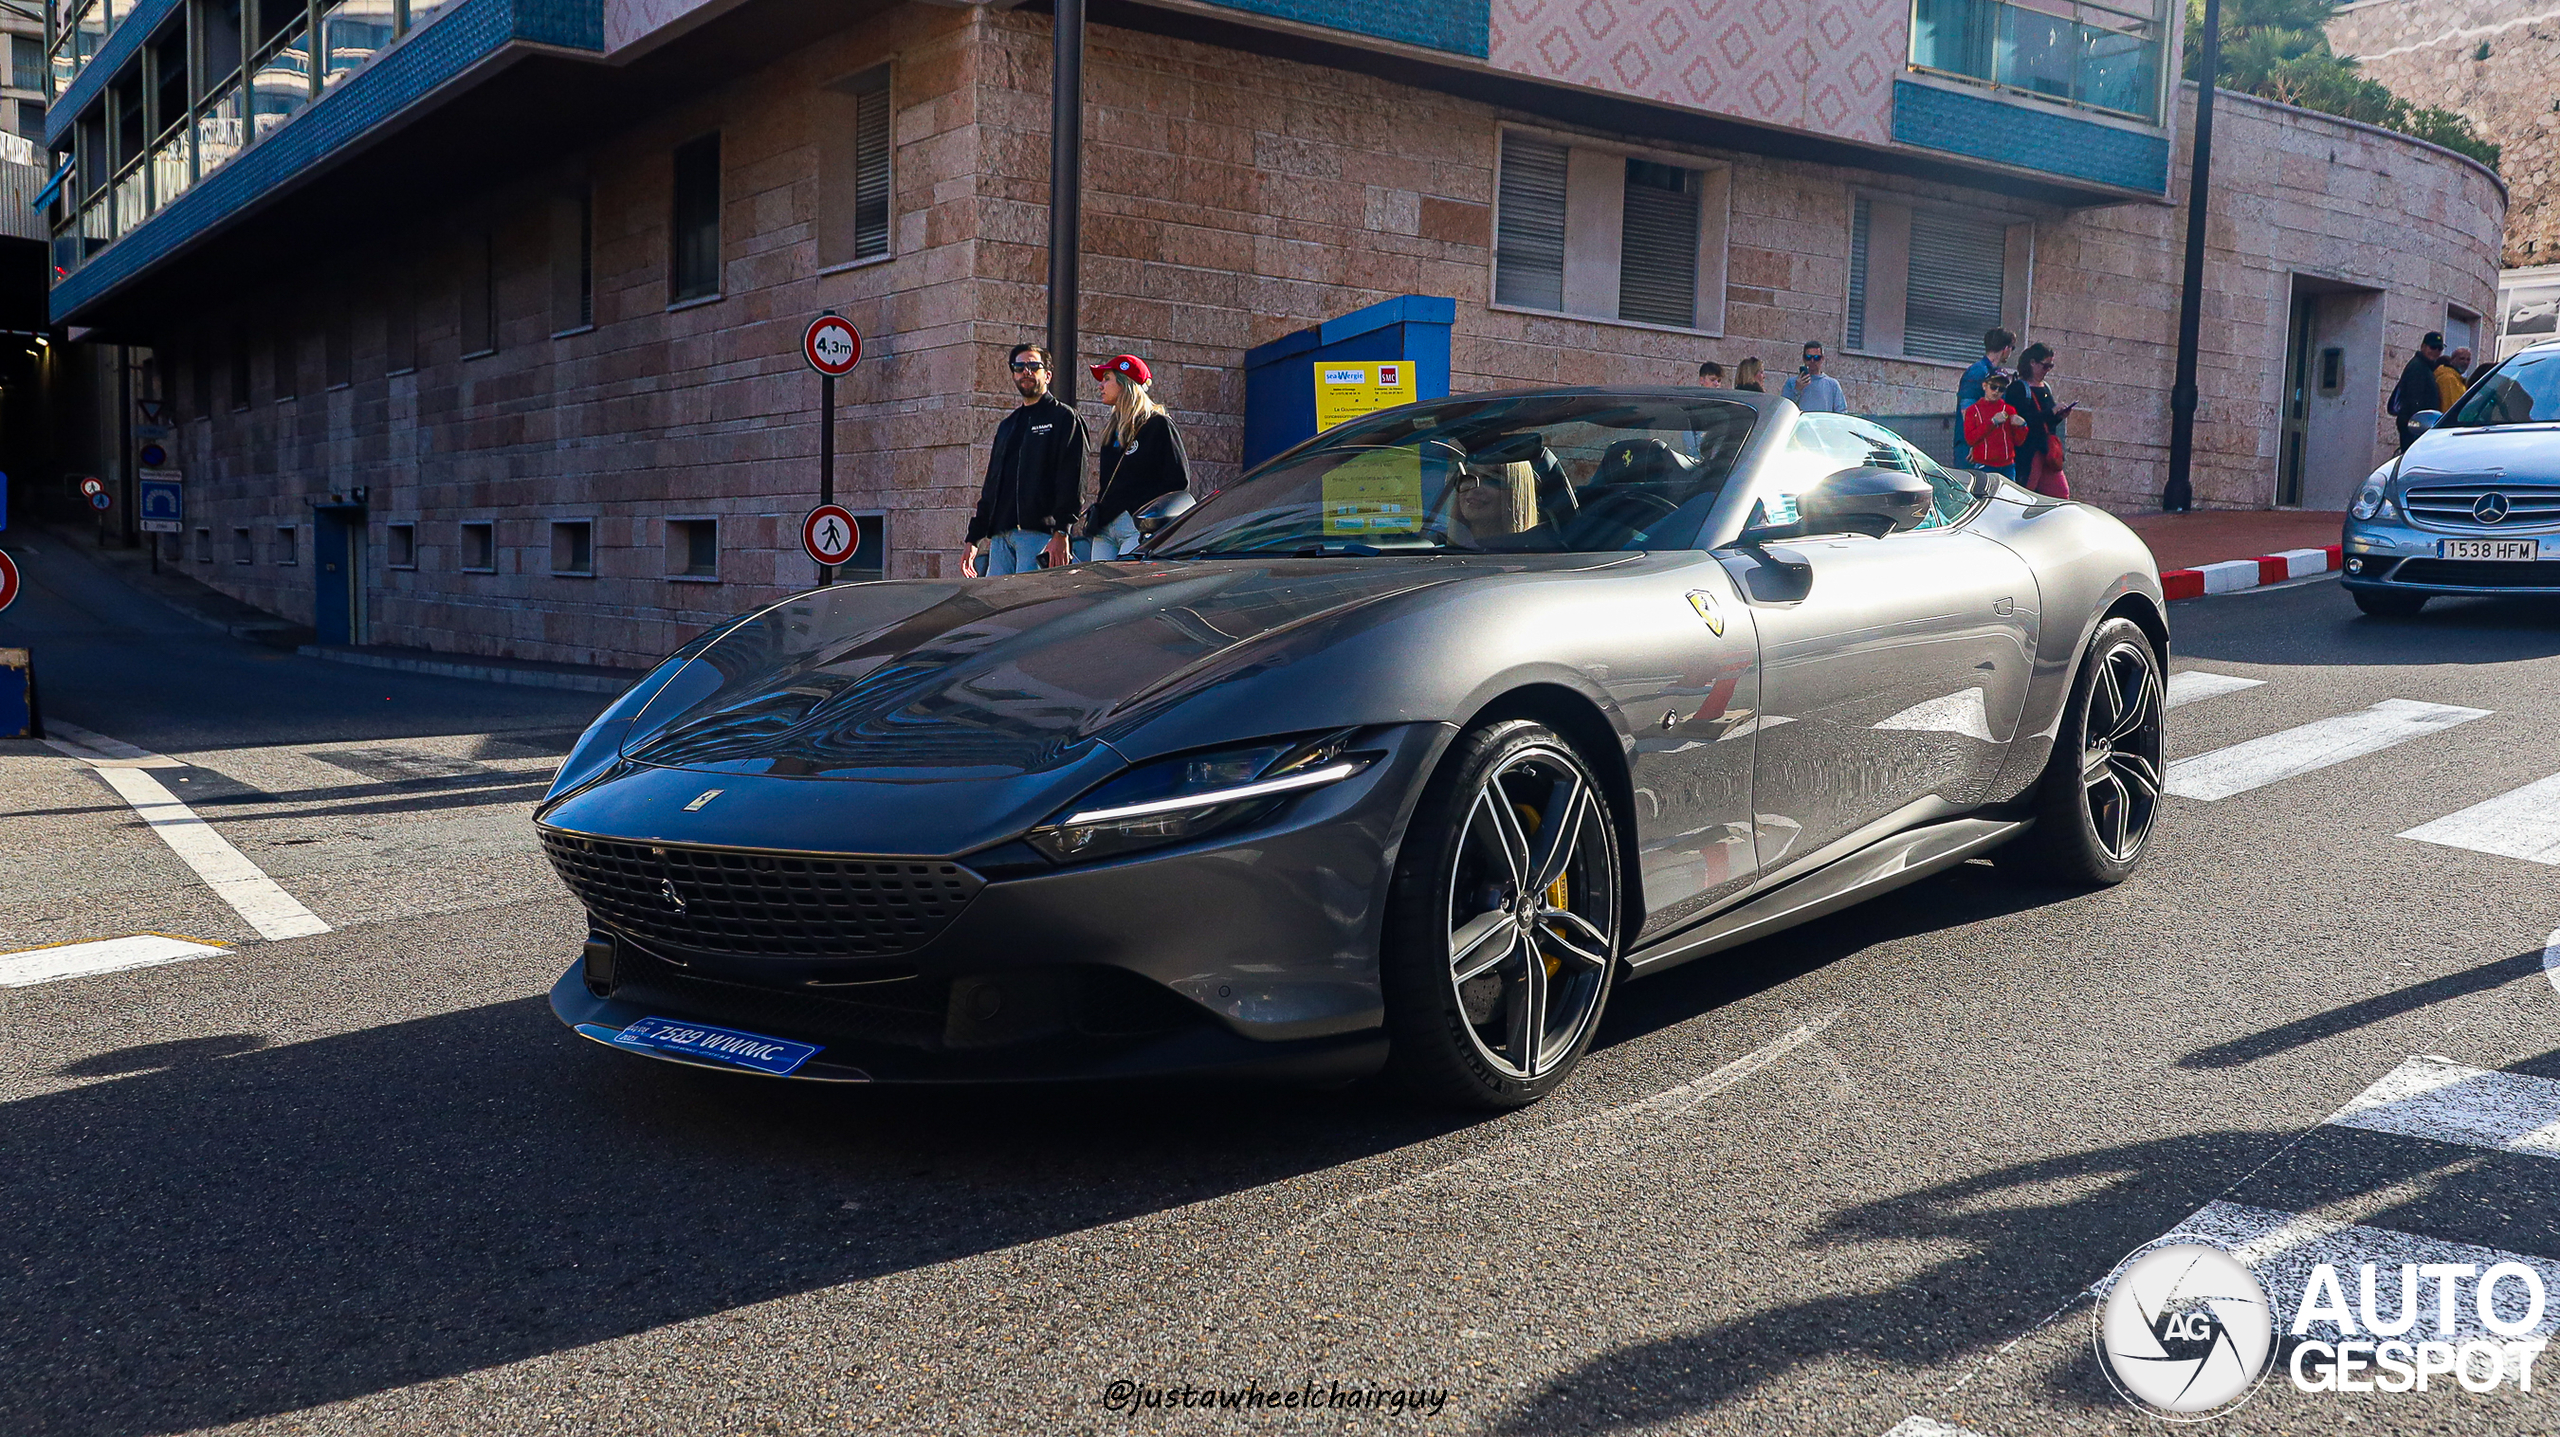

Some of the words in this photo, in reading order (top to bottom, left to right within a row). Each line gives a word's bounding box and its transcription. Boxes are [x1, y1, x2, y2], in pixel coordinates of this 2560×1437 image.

[816, 336, 852, 355] 4,3m
[1381, 373, 1396, 382] SMC
[2449, 542, 2492, 558] 1538
[2496, 542, 2531, 559] HFM
[649, 1026, 705, 1043] 7589
[699, 1032, 784, 1061] WWMC
